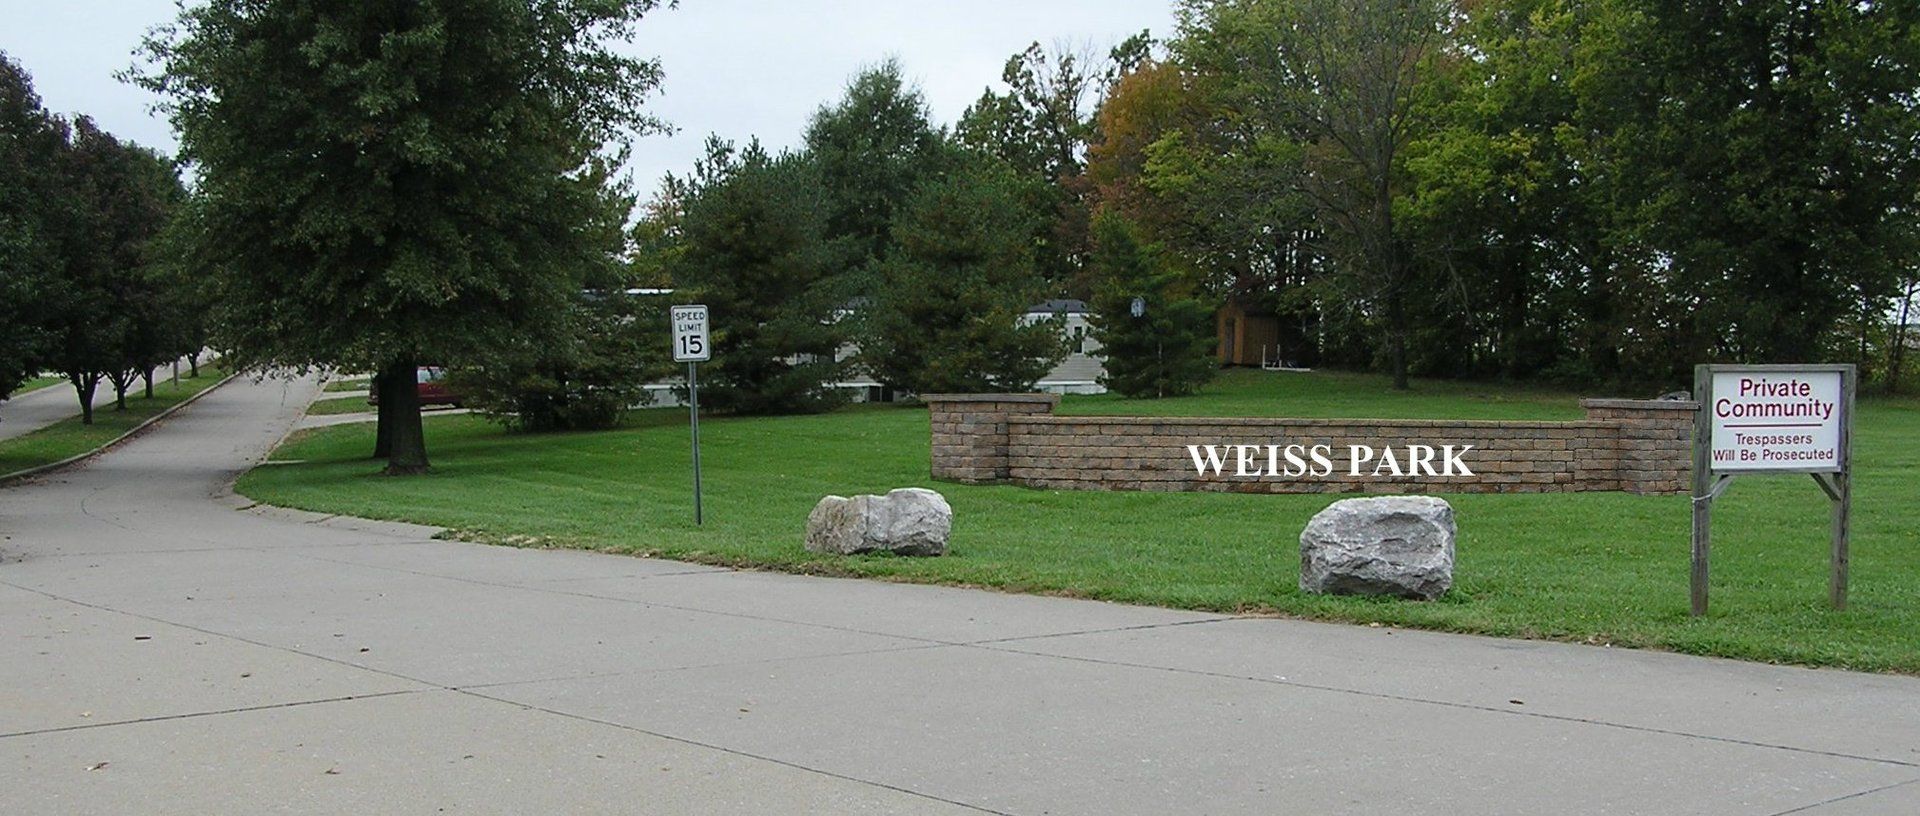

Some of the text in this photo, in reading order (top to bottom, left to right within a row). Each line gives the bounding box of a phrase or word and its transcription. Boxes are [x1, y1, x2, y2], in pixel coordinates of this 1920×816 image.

[675, 312, 705, 320] SPEED
[679, 323, 701, 332] LIMIT
[681, 335, 703, 354] 15
[1740, 378, 1811, 397] Private
[1716, 398, 1833, 420] Community
[1735, 433, 1812, 447] Trespassers
[1713, 448, 1834, 461] Will Be Prosecuted
